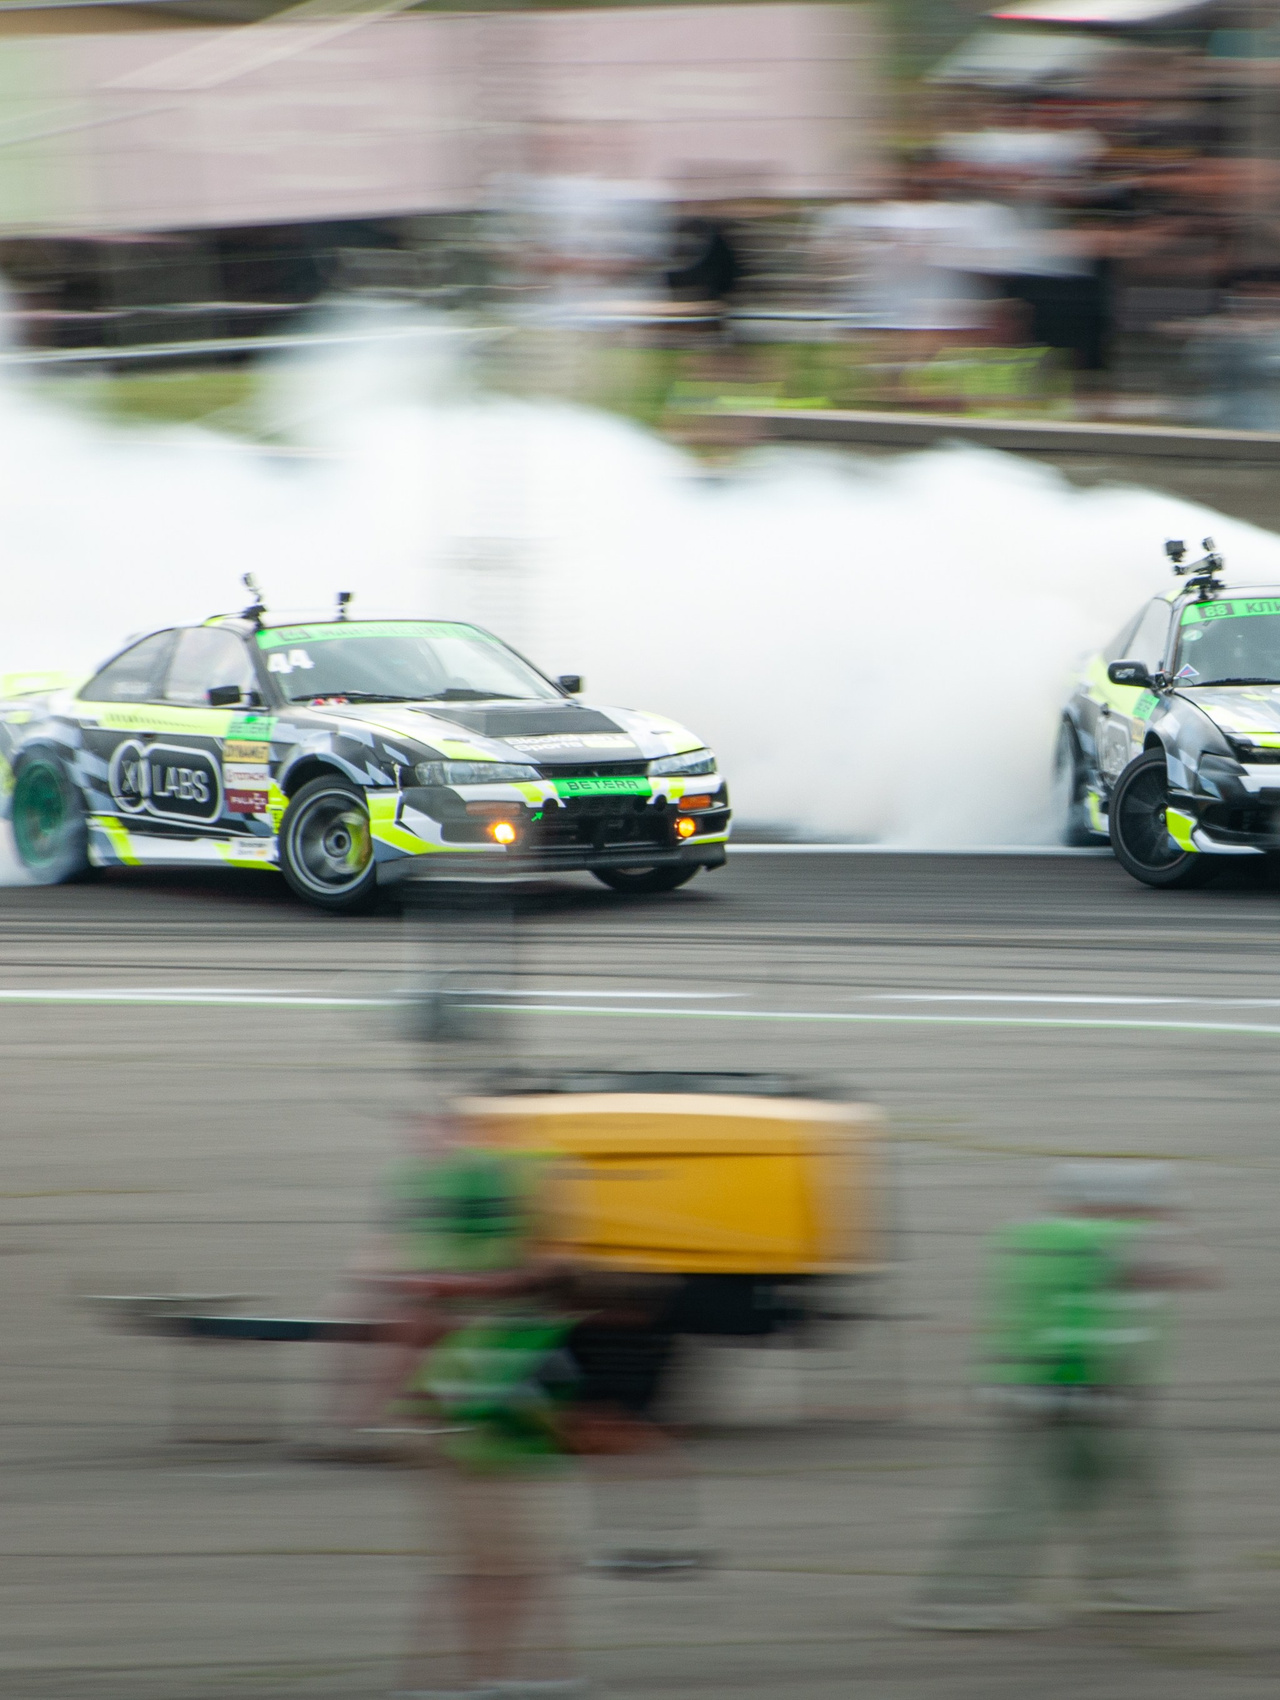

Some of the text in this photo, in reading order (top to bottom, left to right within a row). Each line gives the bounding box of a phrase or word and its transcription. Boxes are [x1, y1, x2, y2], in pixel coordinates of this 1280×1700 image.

[1204, 605, 1227, 617] 88
[267, 649, 315, 675] 44
[152, 764, 210, 803] LABS
